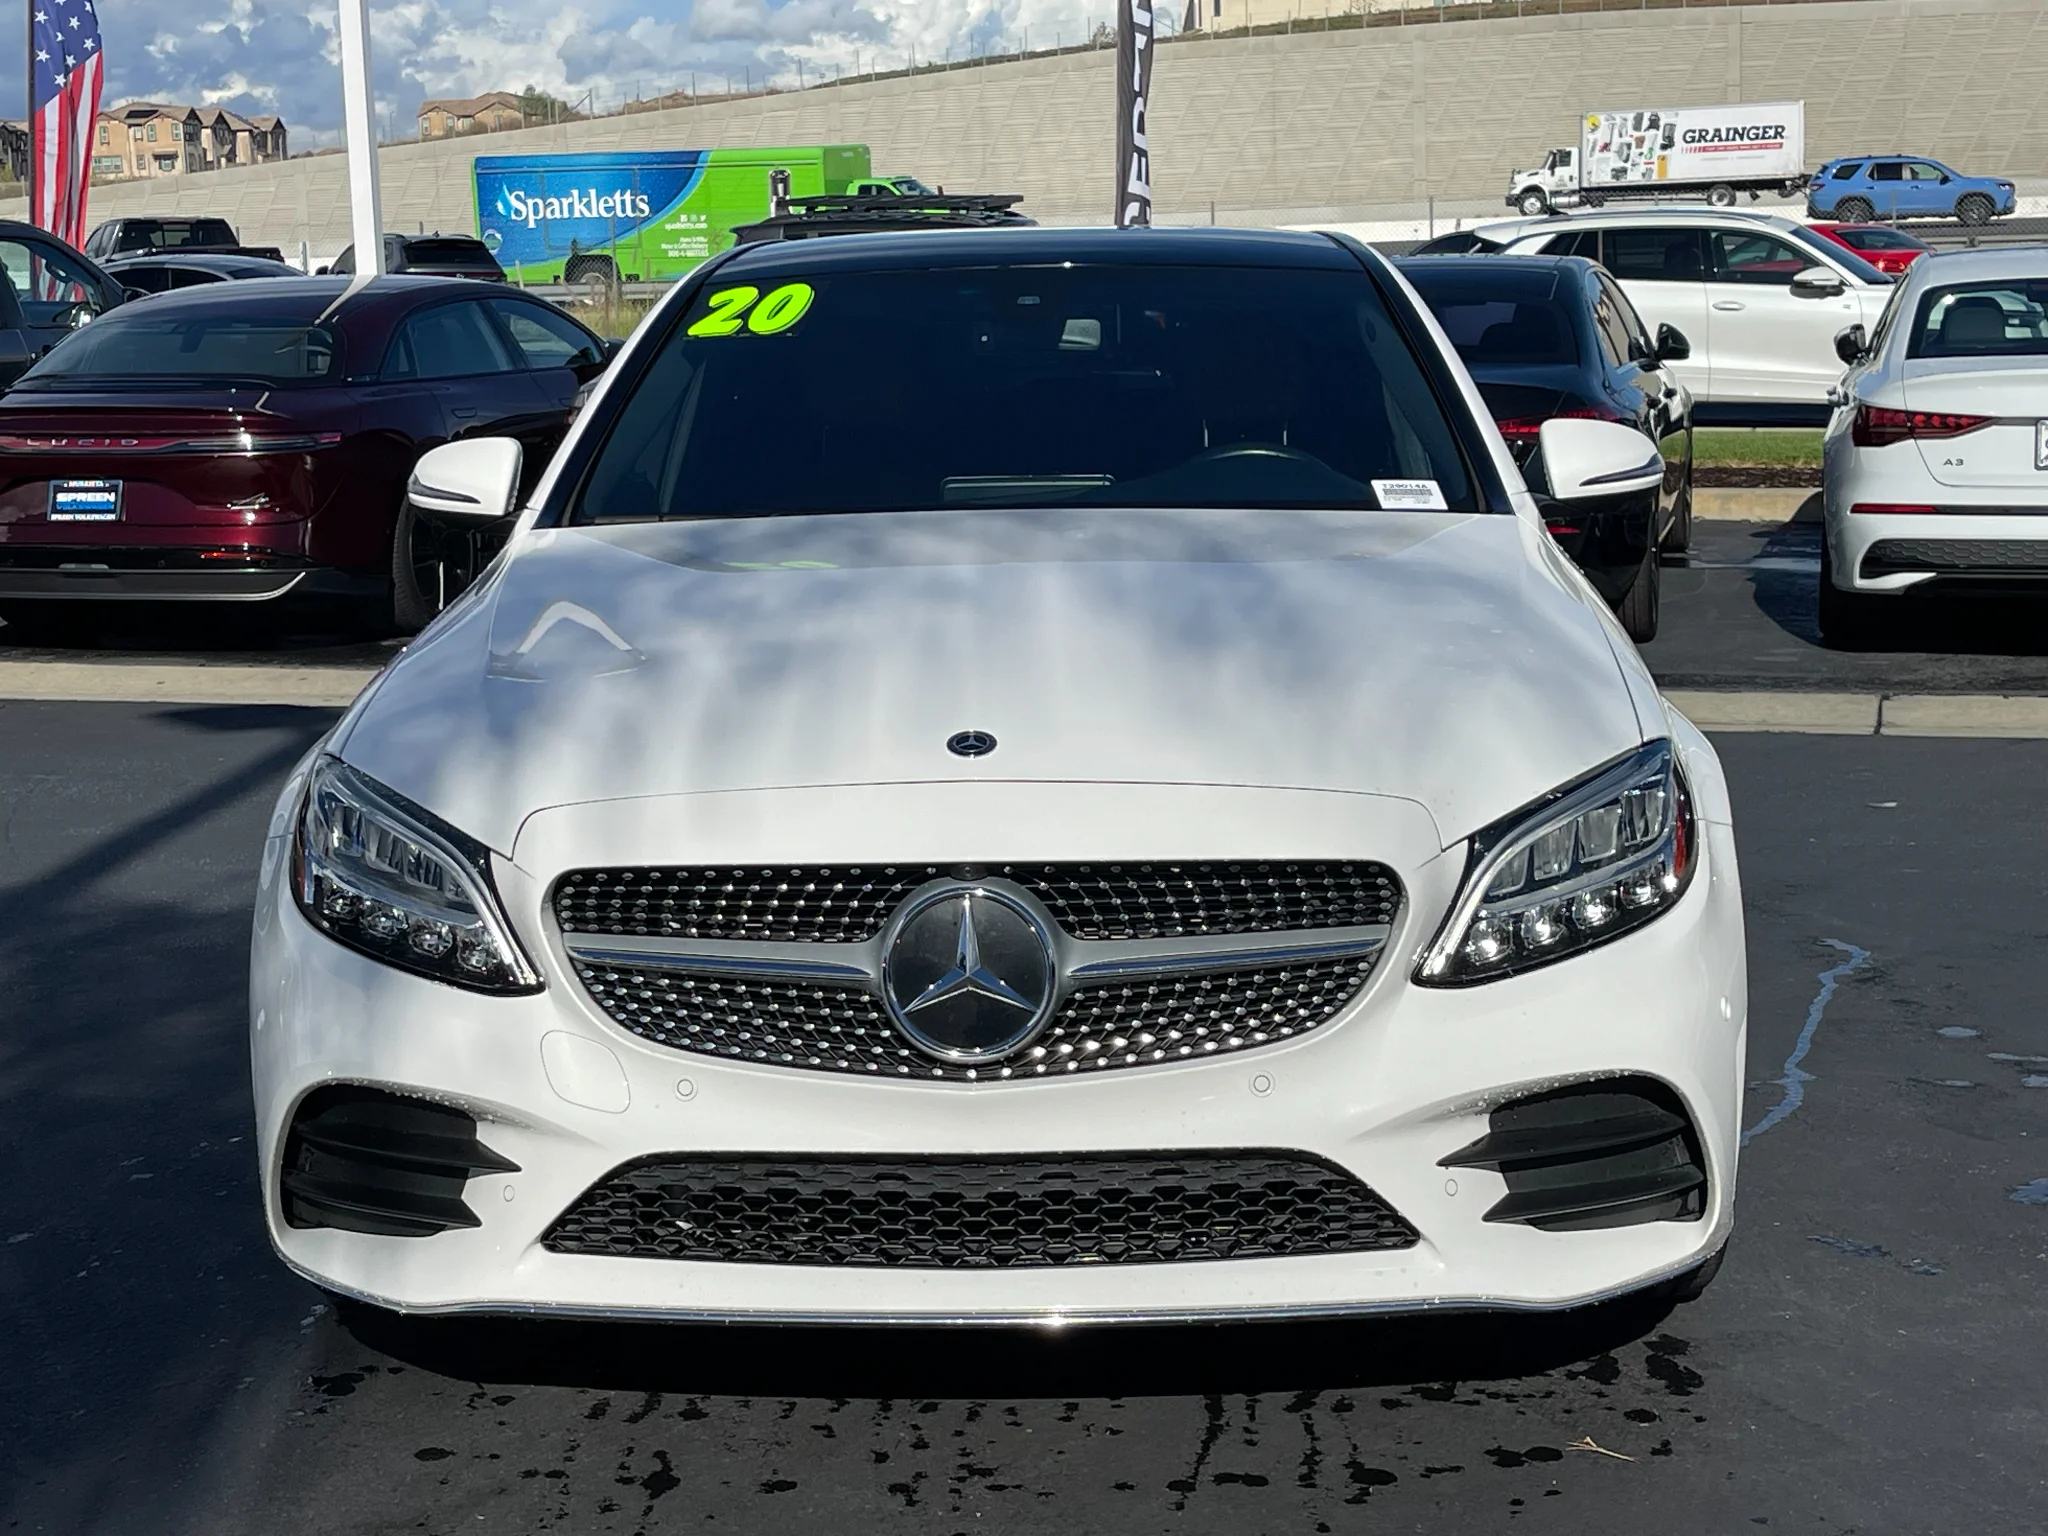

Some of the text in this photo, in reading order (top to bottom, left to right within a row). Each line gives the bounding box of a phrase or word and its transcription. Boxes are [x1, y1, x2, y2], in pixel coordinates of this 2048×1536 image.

[1682, 124, 1786, 144] GRAINGER
[510, 188, 650, 228] Sparkletts
[687, 283, 815, 338] 20
[27, 438, 139, 446] LUCID
[1942, 458, 1964, 467] A3
[56, 492, 116, 502] SPREEN
